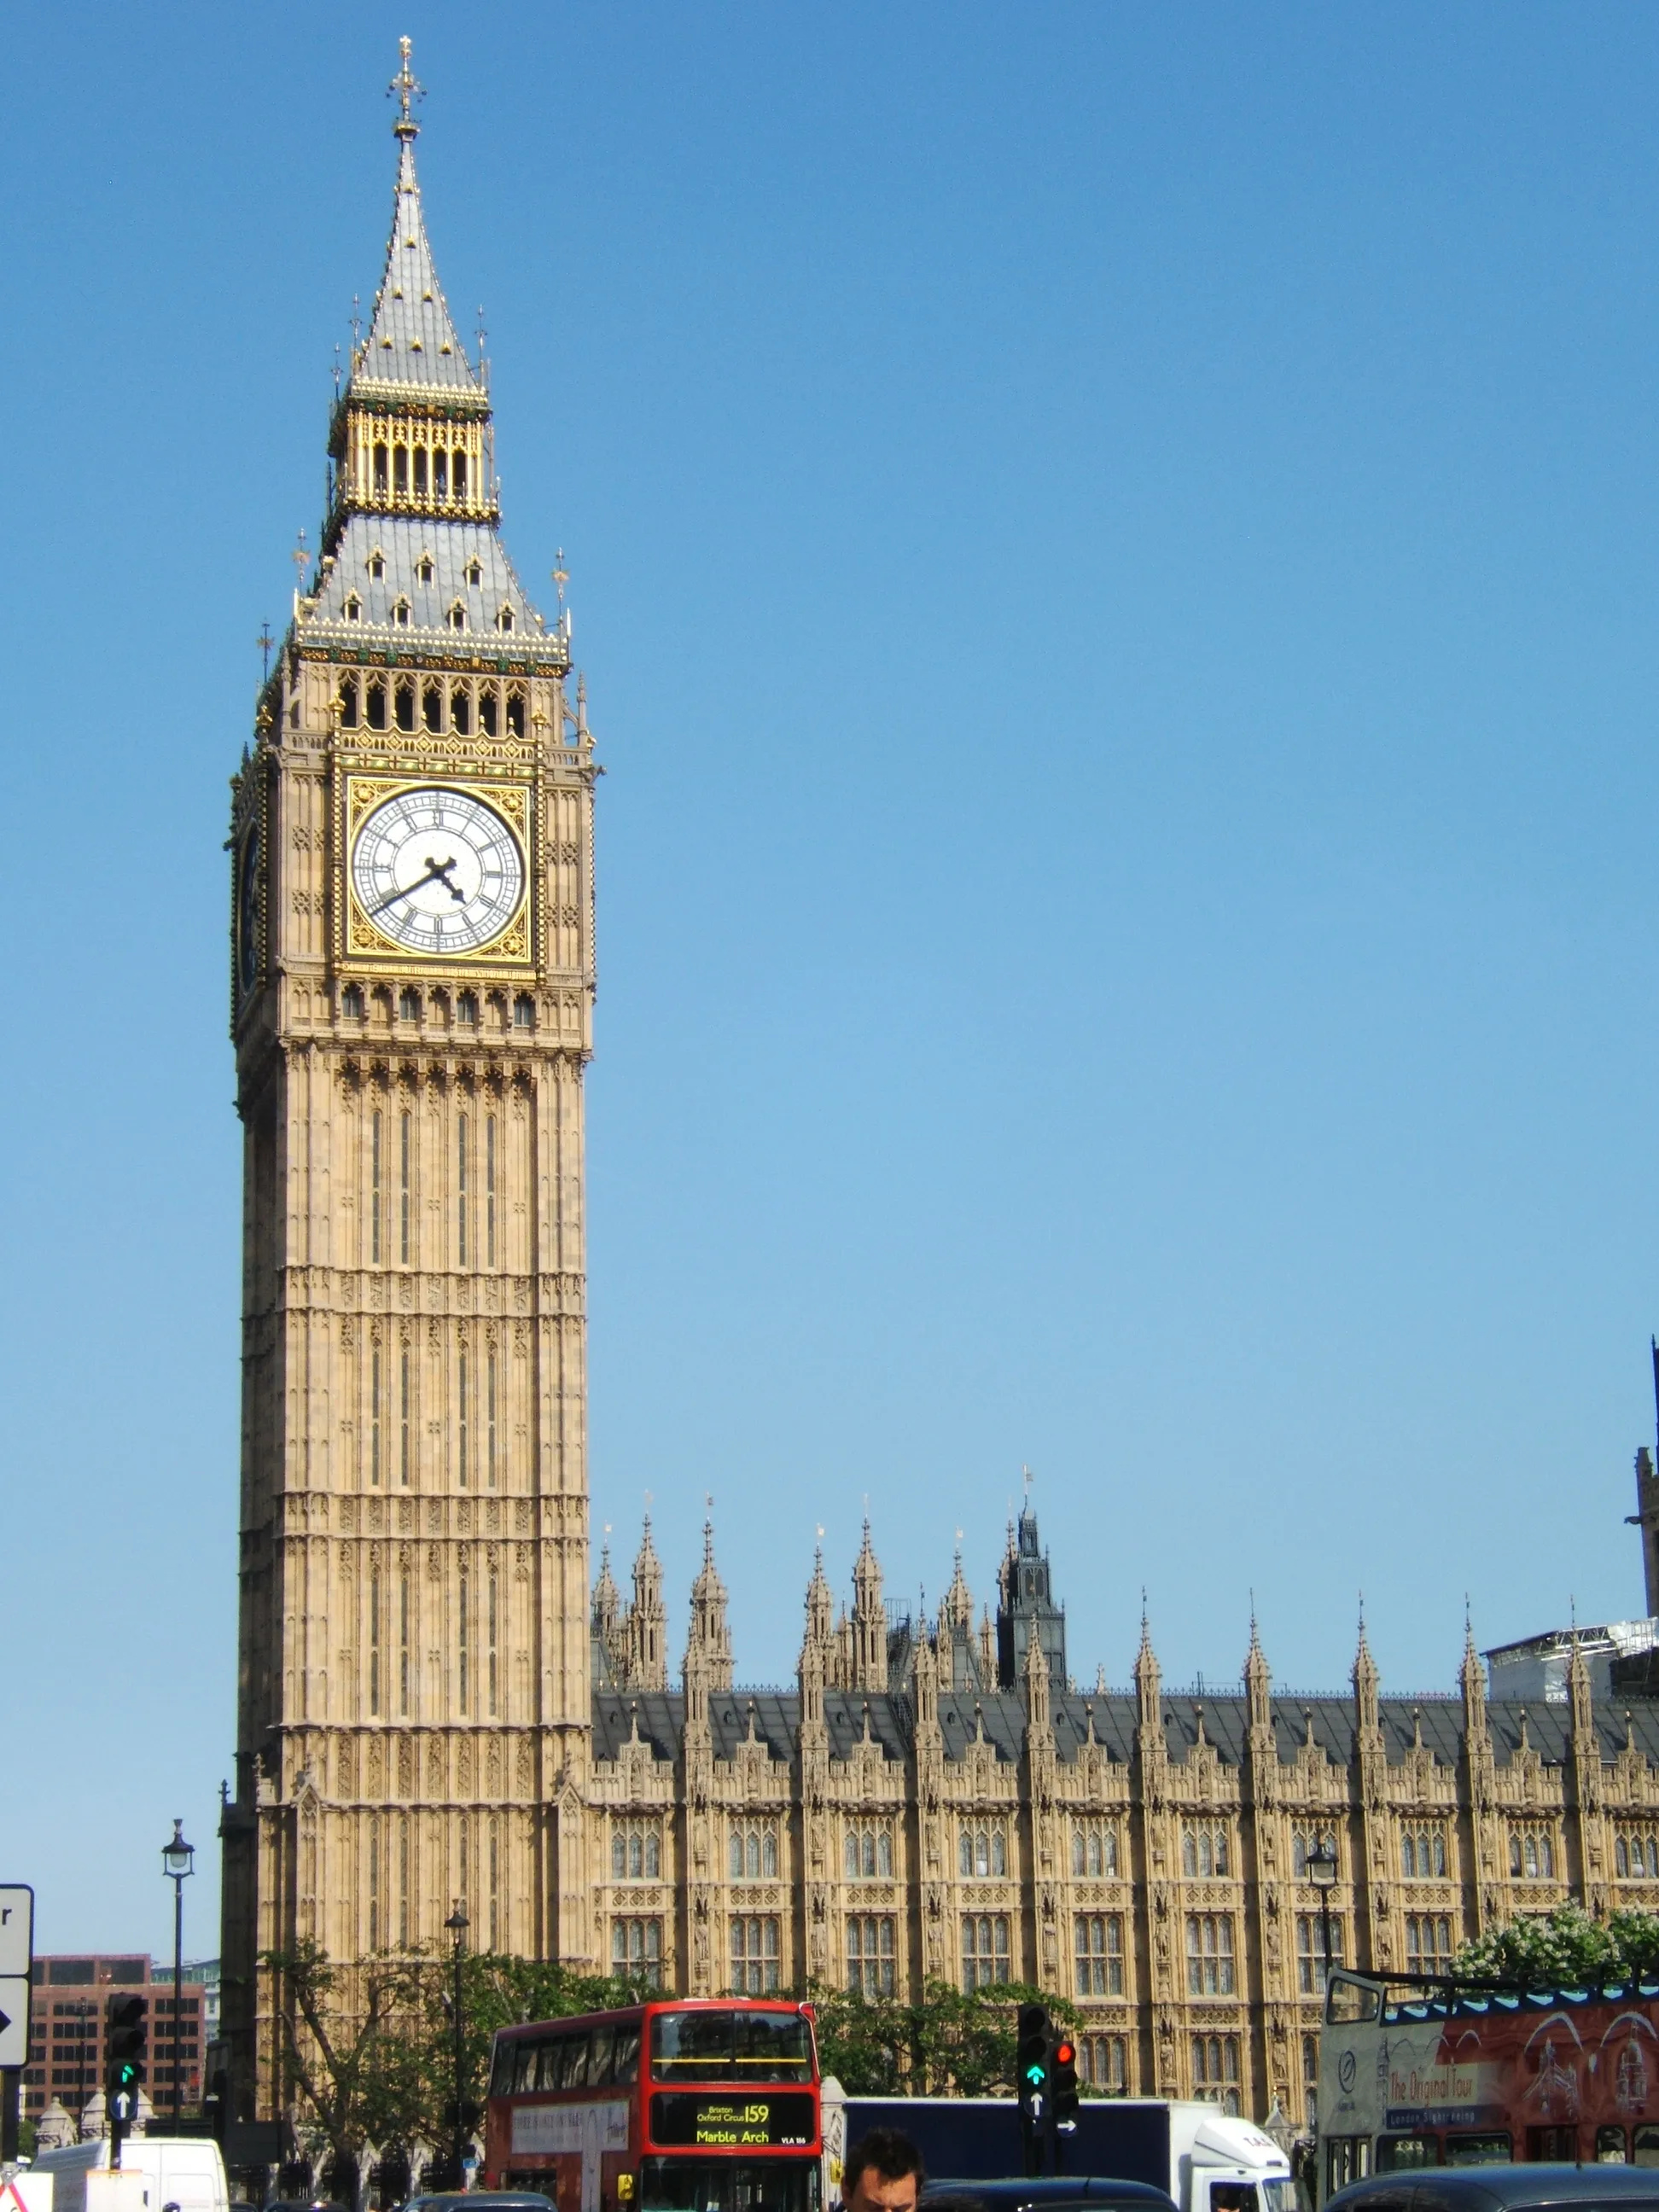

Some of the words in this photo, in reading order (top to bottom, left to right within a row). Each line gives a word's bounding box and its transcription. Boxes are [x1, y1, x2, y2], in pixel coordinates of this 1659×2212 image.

[708, 2105, 733, 2114] Brixton
[745, 2104, 769, 2123] 159
[696, 2113, 721, 2122] Oxford
[723, 2113, 745, 2122] Circus
[696, 2131, 736, 2143] Marble
[741, 2131, 769, 2143] Arch
